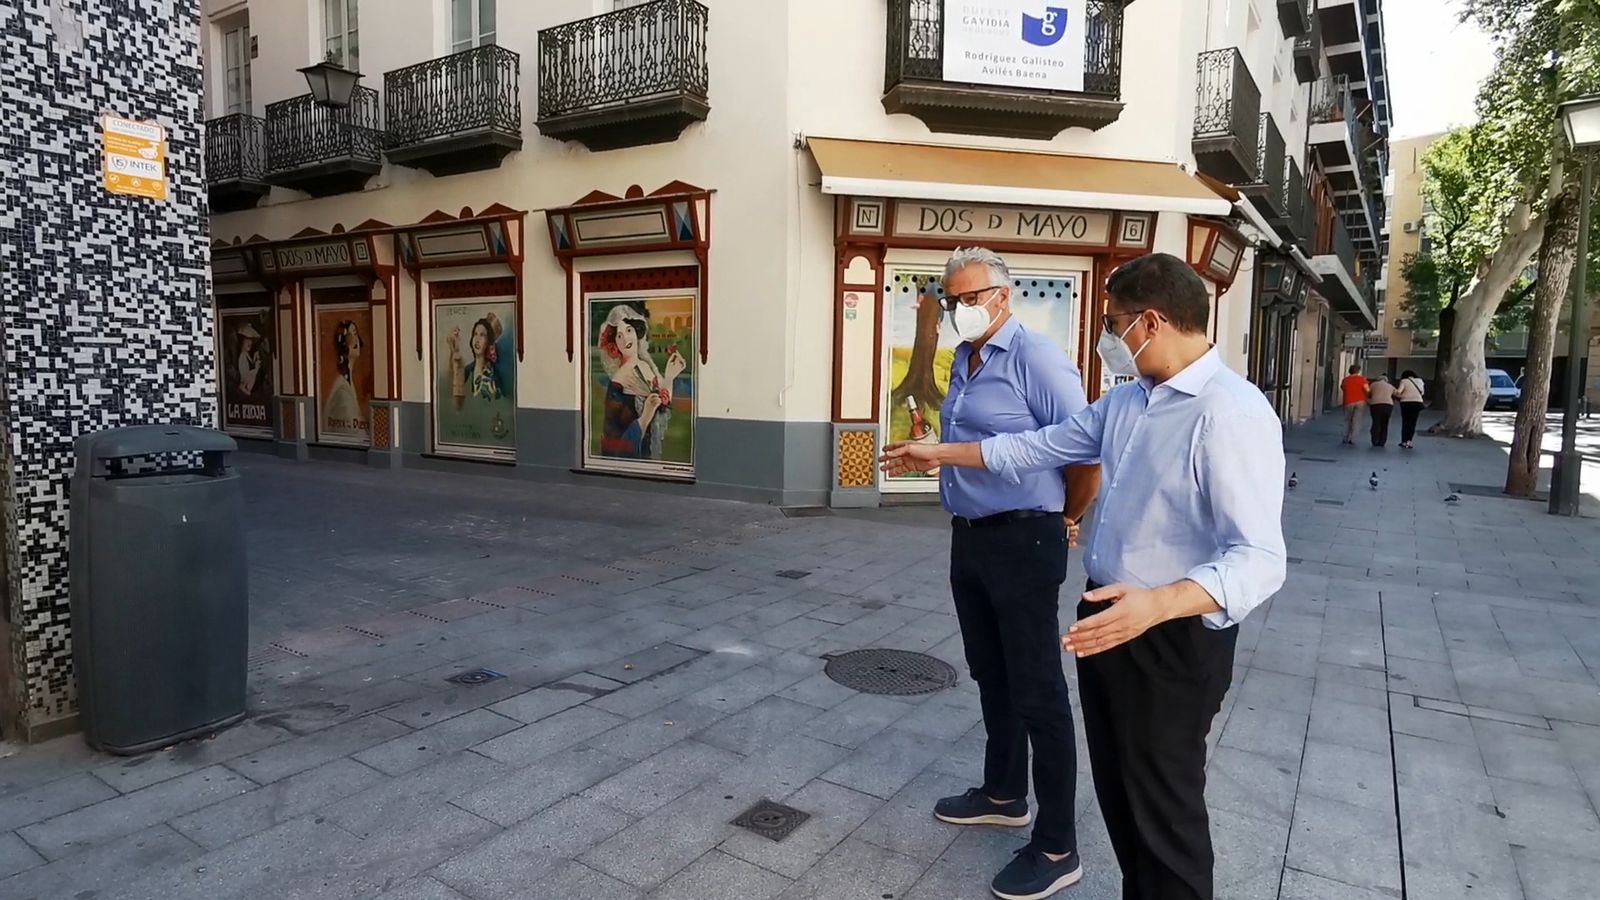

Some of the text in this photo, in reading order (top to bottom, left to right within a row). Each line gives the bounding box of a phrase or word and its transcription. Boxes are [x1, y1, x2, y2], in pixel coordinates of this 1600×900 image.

[963, 15, 1010, 28] GAVIDIA
[1022, 56, 1064, 68] Galisteo
[981, 66, 1047, 79] Avilés Baena
[130, 160, 158, 172] INTEK
[918, 206, 1088, 239] DOS D MAYO
[1130, 223, 1138, 237] 6
[279, 249, 303, 267] DOS
[304, 250, 313, 262] D
[314, 244, 348, 264] MAYO
[228, 403, 266, 420] LA RIOJA
